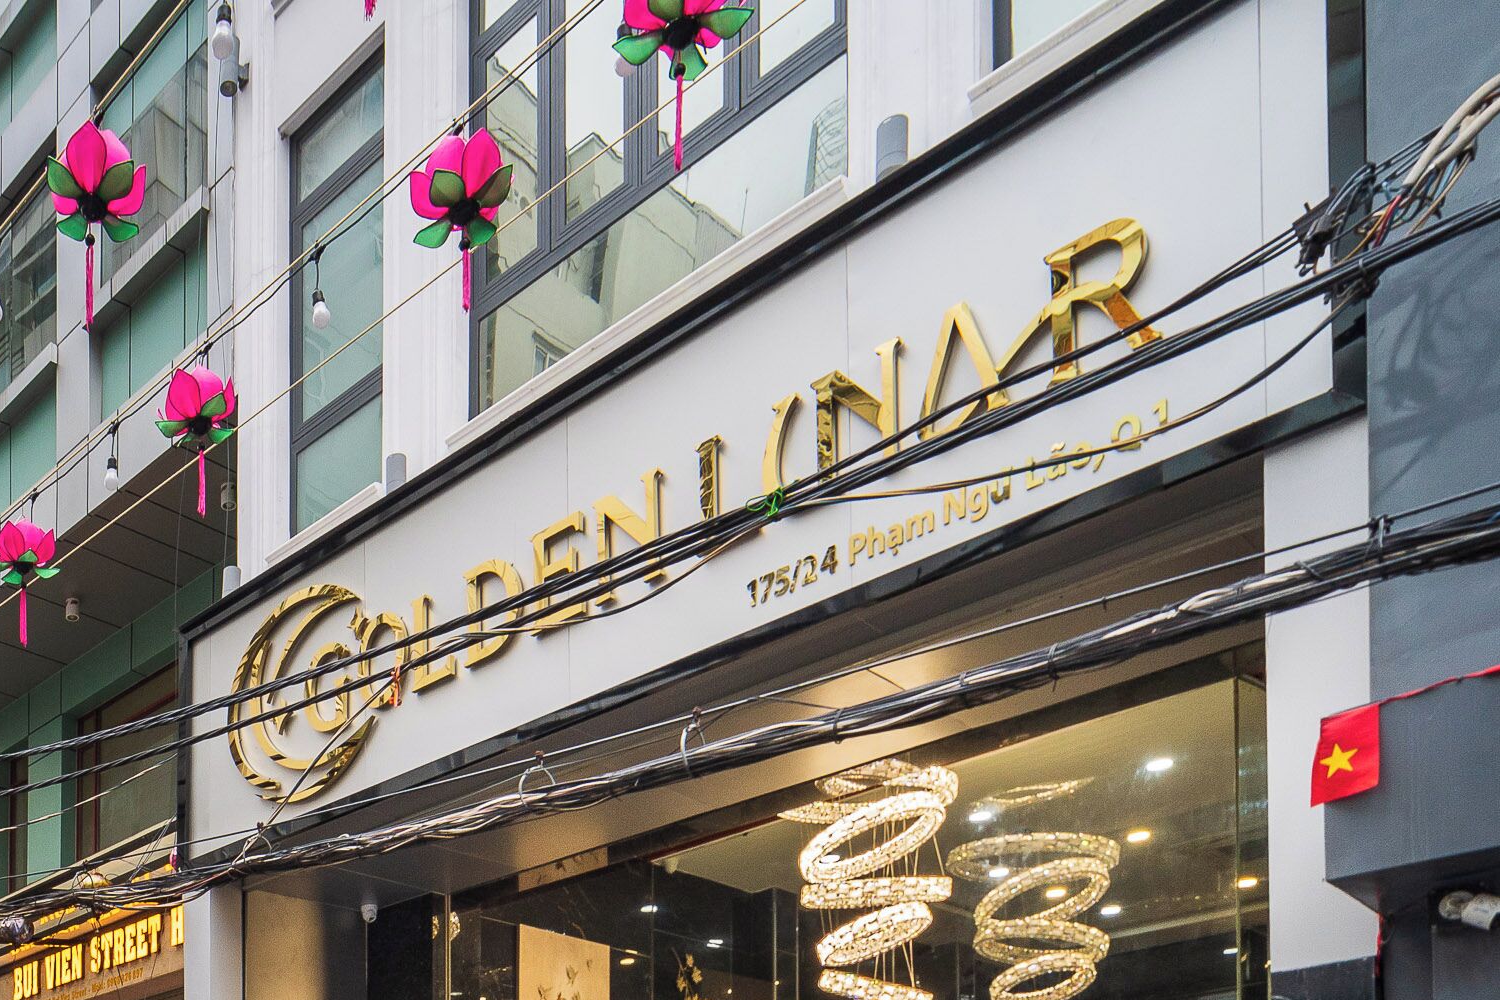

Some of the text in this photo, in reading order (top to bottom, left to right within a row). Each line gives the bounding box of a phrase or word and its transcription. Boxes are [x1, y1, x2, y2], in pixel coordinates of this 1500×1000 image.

[746, 545, 838, 607] 175/24
[848, 514, 936, 566] Phạm
[44, 943, 83, 990] VIEN
[89, 913, 162, 974] STREET
